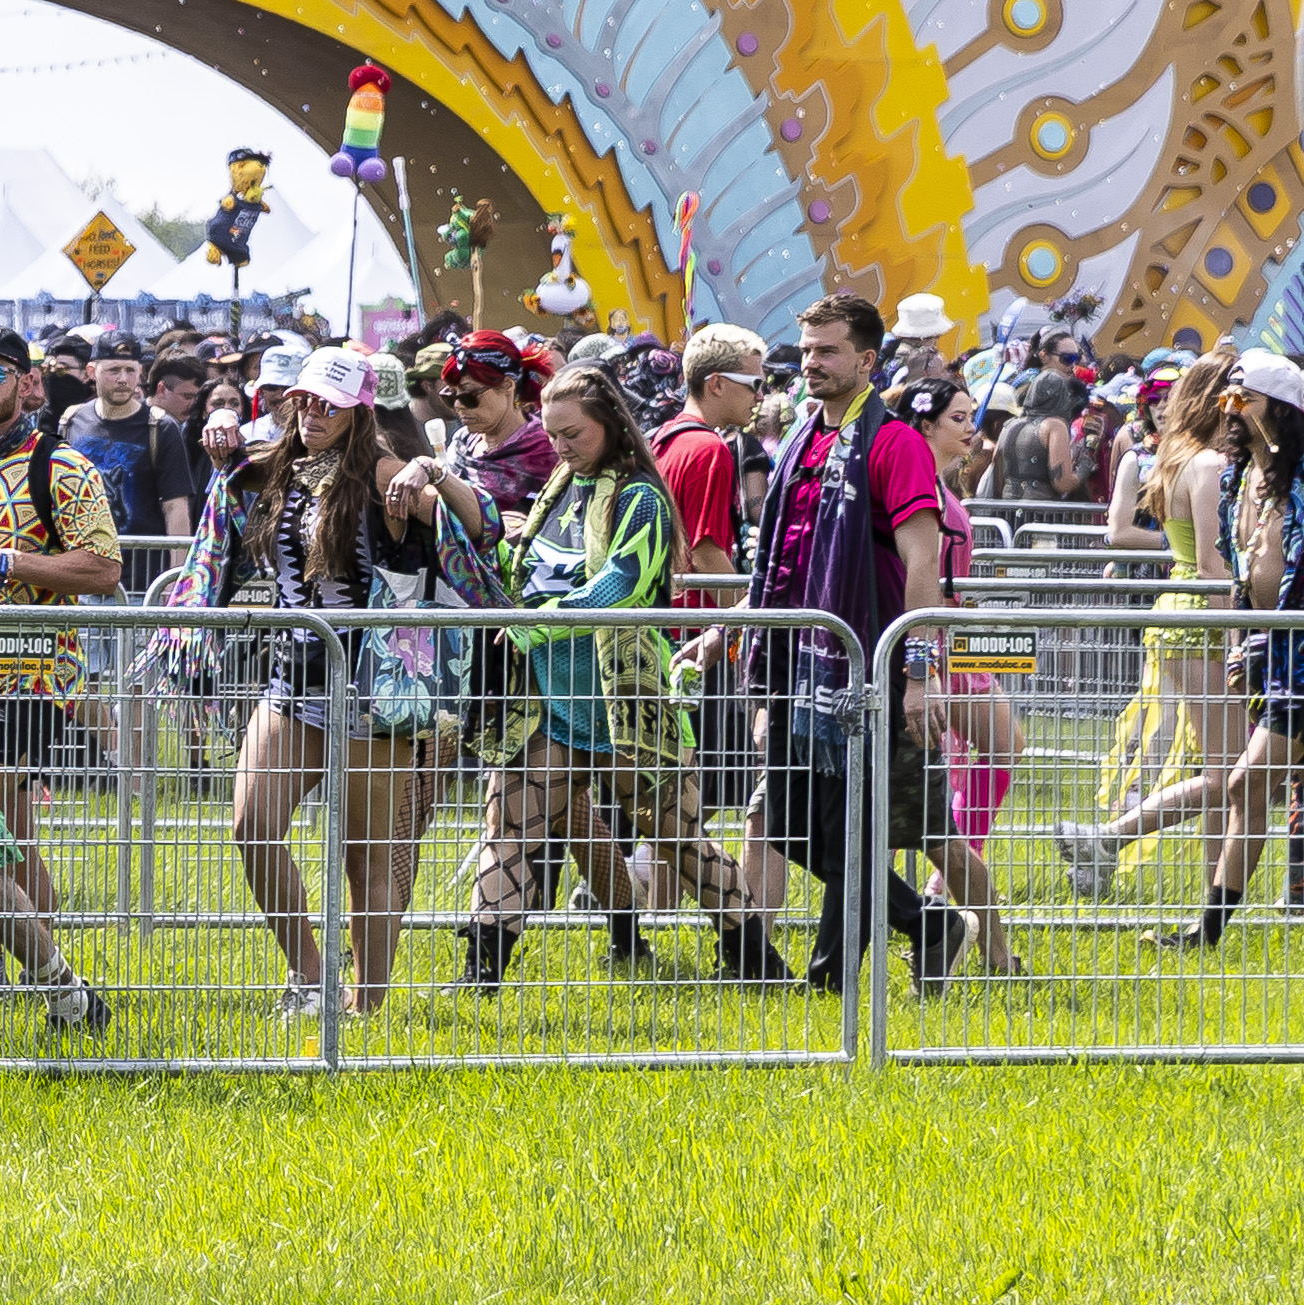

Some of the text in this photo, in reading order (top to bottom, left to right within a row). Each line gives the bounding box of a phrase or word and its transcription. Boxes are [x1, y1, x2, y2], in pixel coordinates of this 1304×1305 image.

[231, 589, 271, 603] DU-LOC
[969, 637, 1033, 653] MODU-LOC
[951, 660, 1032, 669] www.moduloc.ca
